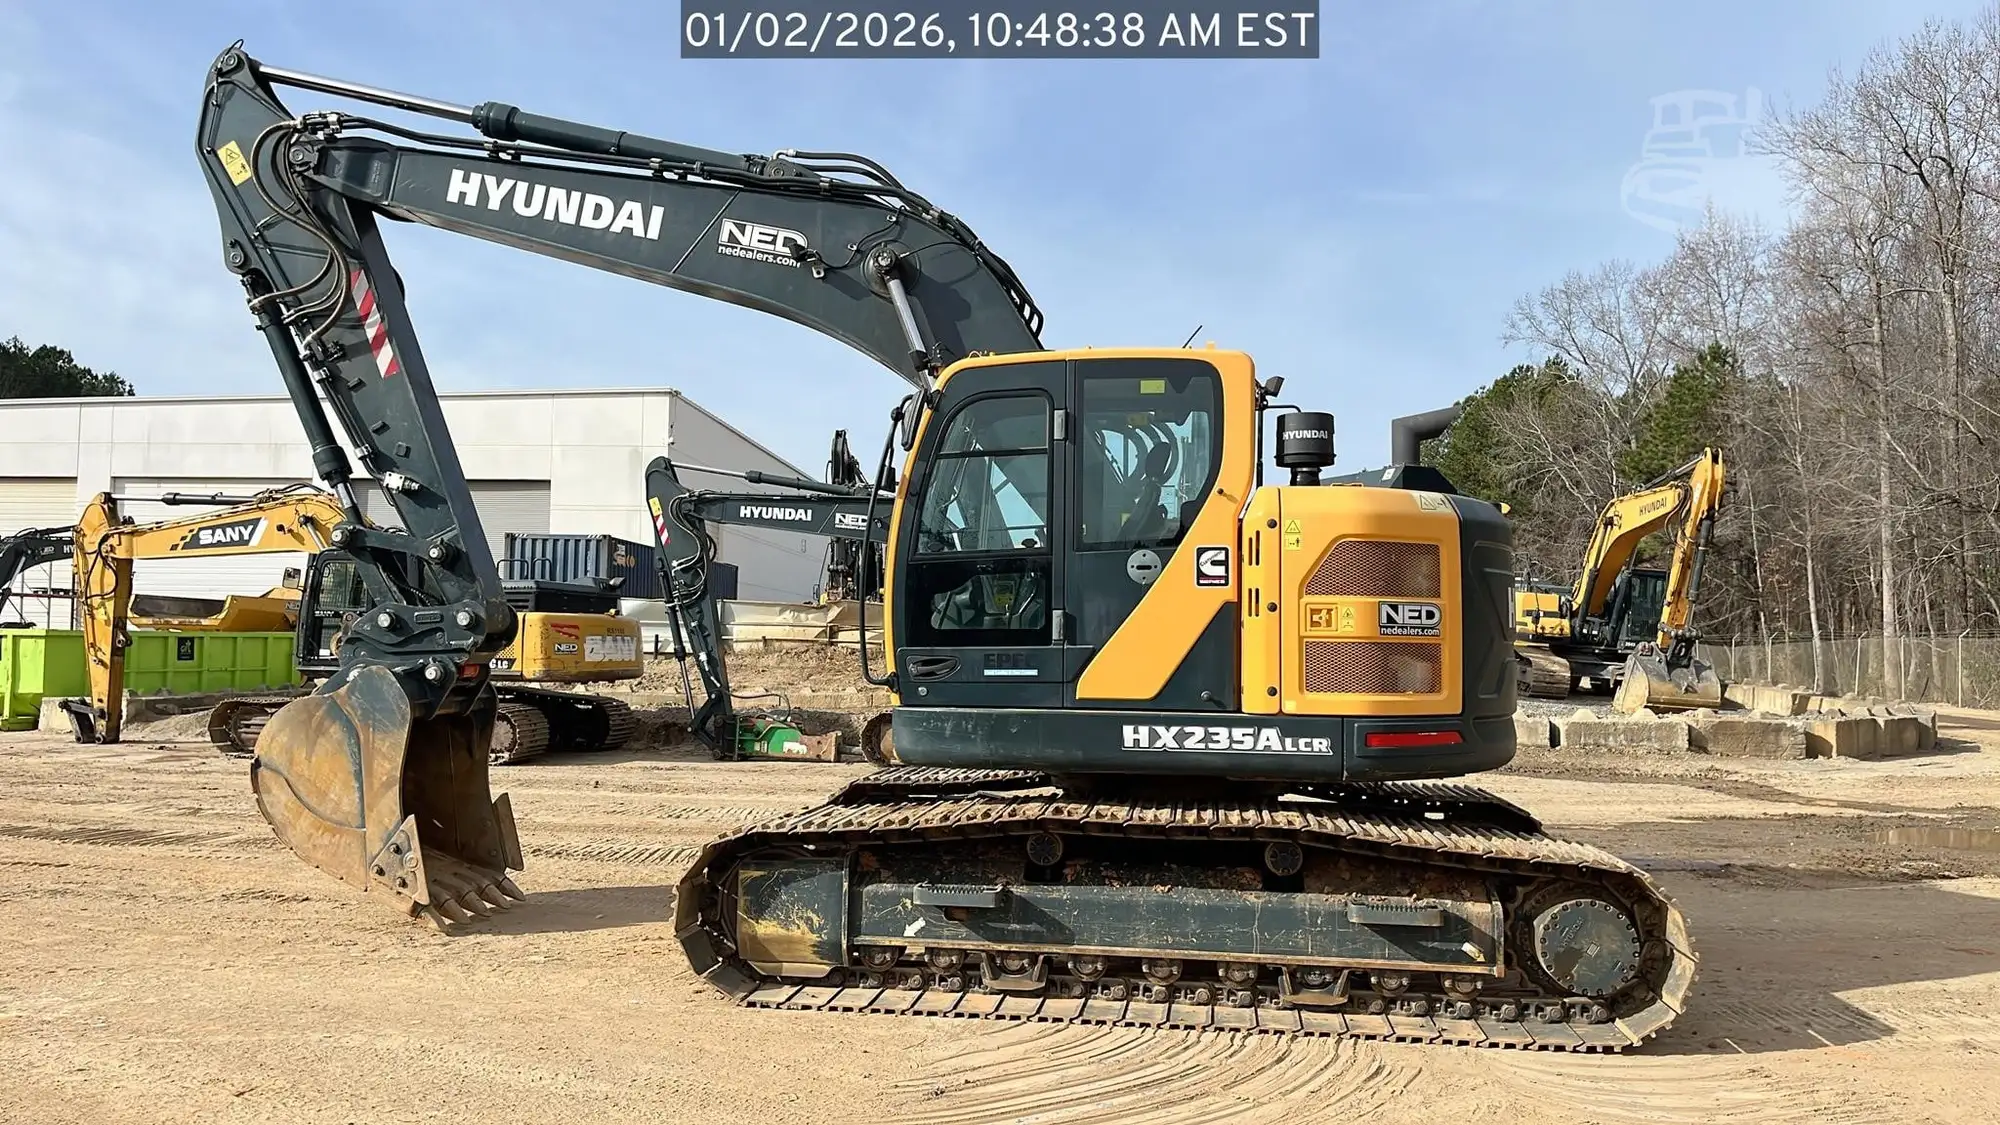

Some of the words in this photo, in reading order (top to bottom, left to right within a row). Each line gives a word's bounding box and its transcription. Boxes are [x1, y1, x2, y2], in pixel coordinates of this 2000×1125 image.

[446, 168, 665, 241] HYUNDAI
[720, 219, 808, 255] NED
[1282, 430, 1328, 440] HYUNDAI
[739, 505, 813, 521] HYUNDAI
[1639, 497, 1667, 516] HYUNDAI
[199, 525, 254, 545] SANY
[1381, 604, 1441, 625] NED
[1380, 626, 1440, 636] nedealers.com
[555, 643, 578, 652] NED
